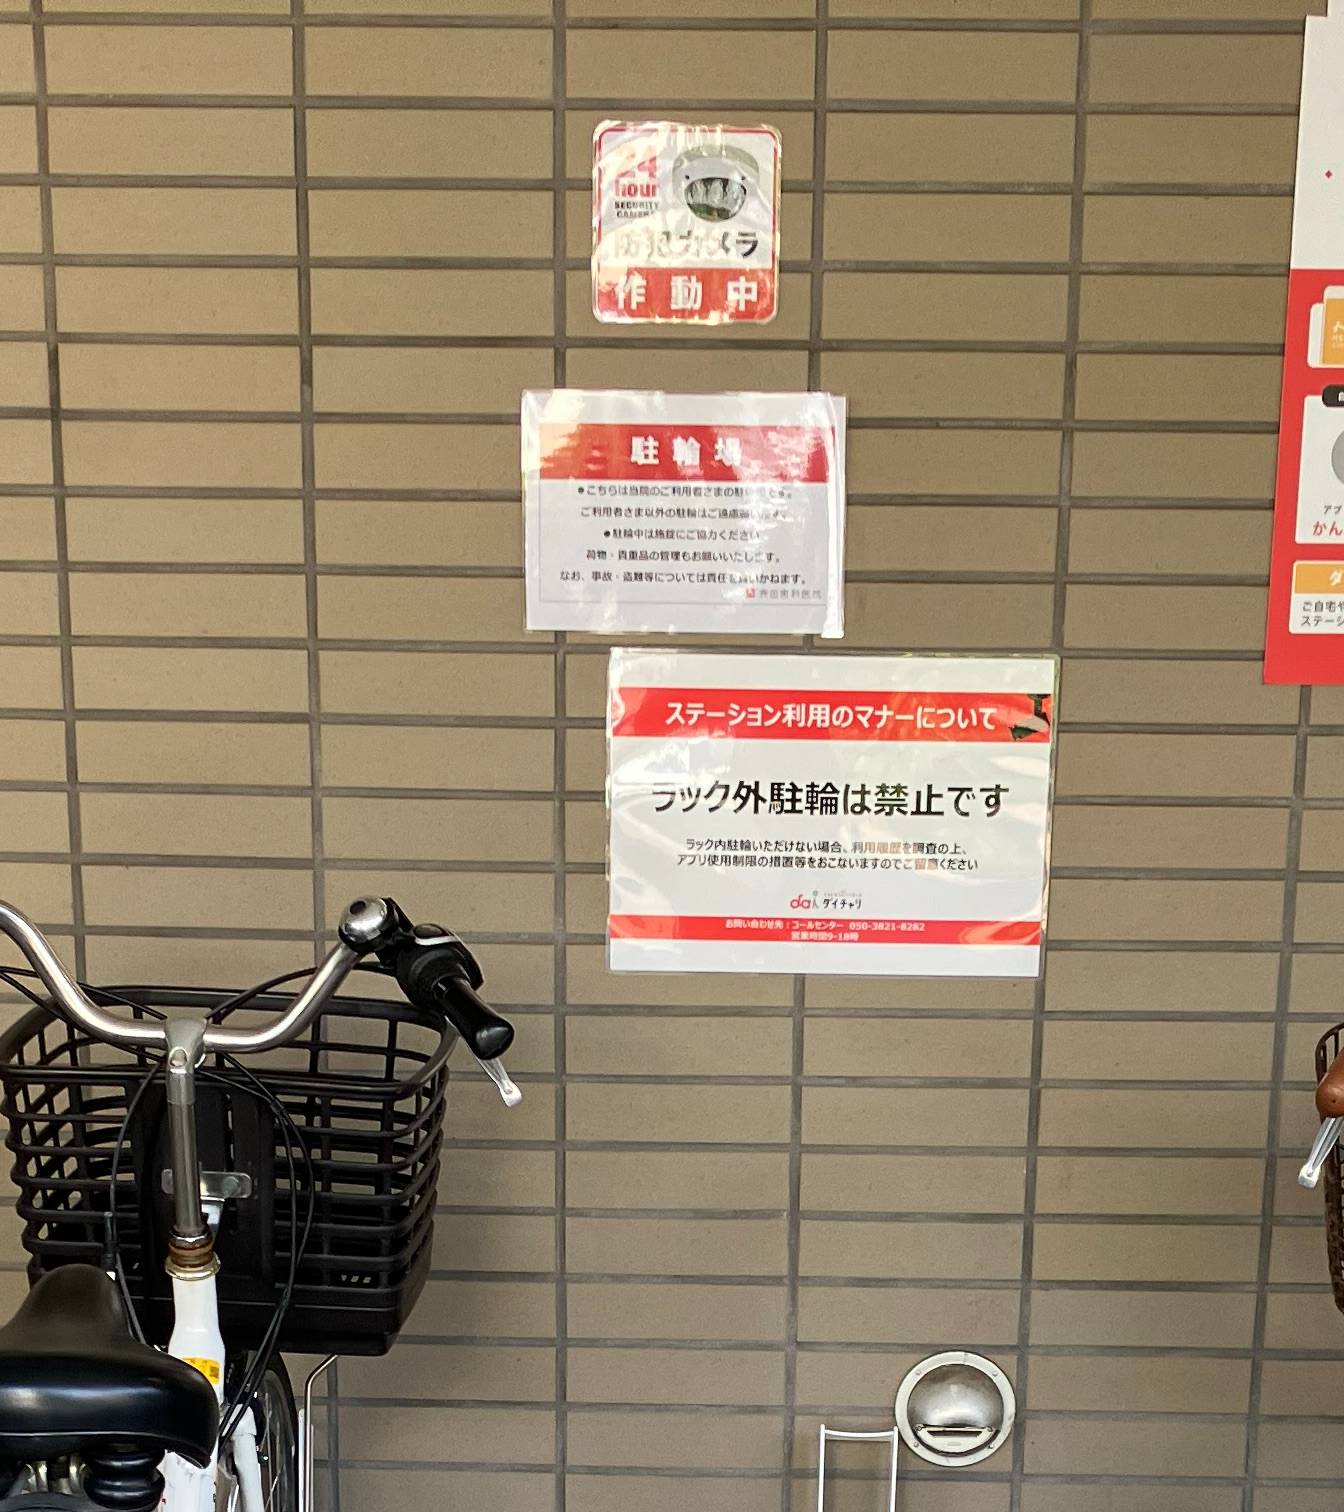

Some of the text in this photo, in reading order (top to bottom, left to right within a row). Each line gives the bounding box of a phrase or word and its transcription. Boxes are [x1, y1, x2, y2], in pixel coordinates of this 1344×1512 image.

[615, 273, 758, 310] 作動中
[630, 435, 743, 467] 駐輪場
[665, 701, 998, 731] ステーション利用のマナーについて
[652, 780, 1010, 818] ラック外駐輪は禁止です
[823, 897, 863, 910] ダイチャリ
